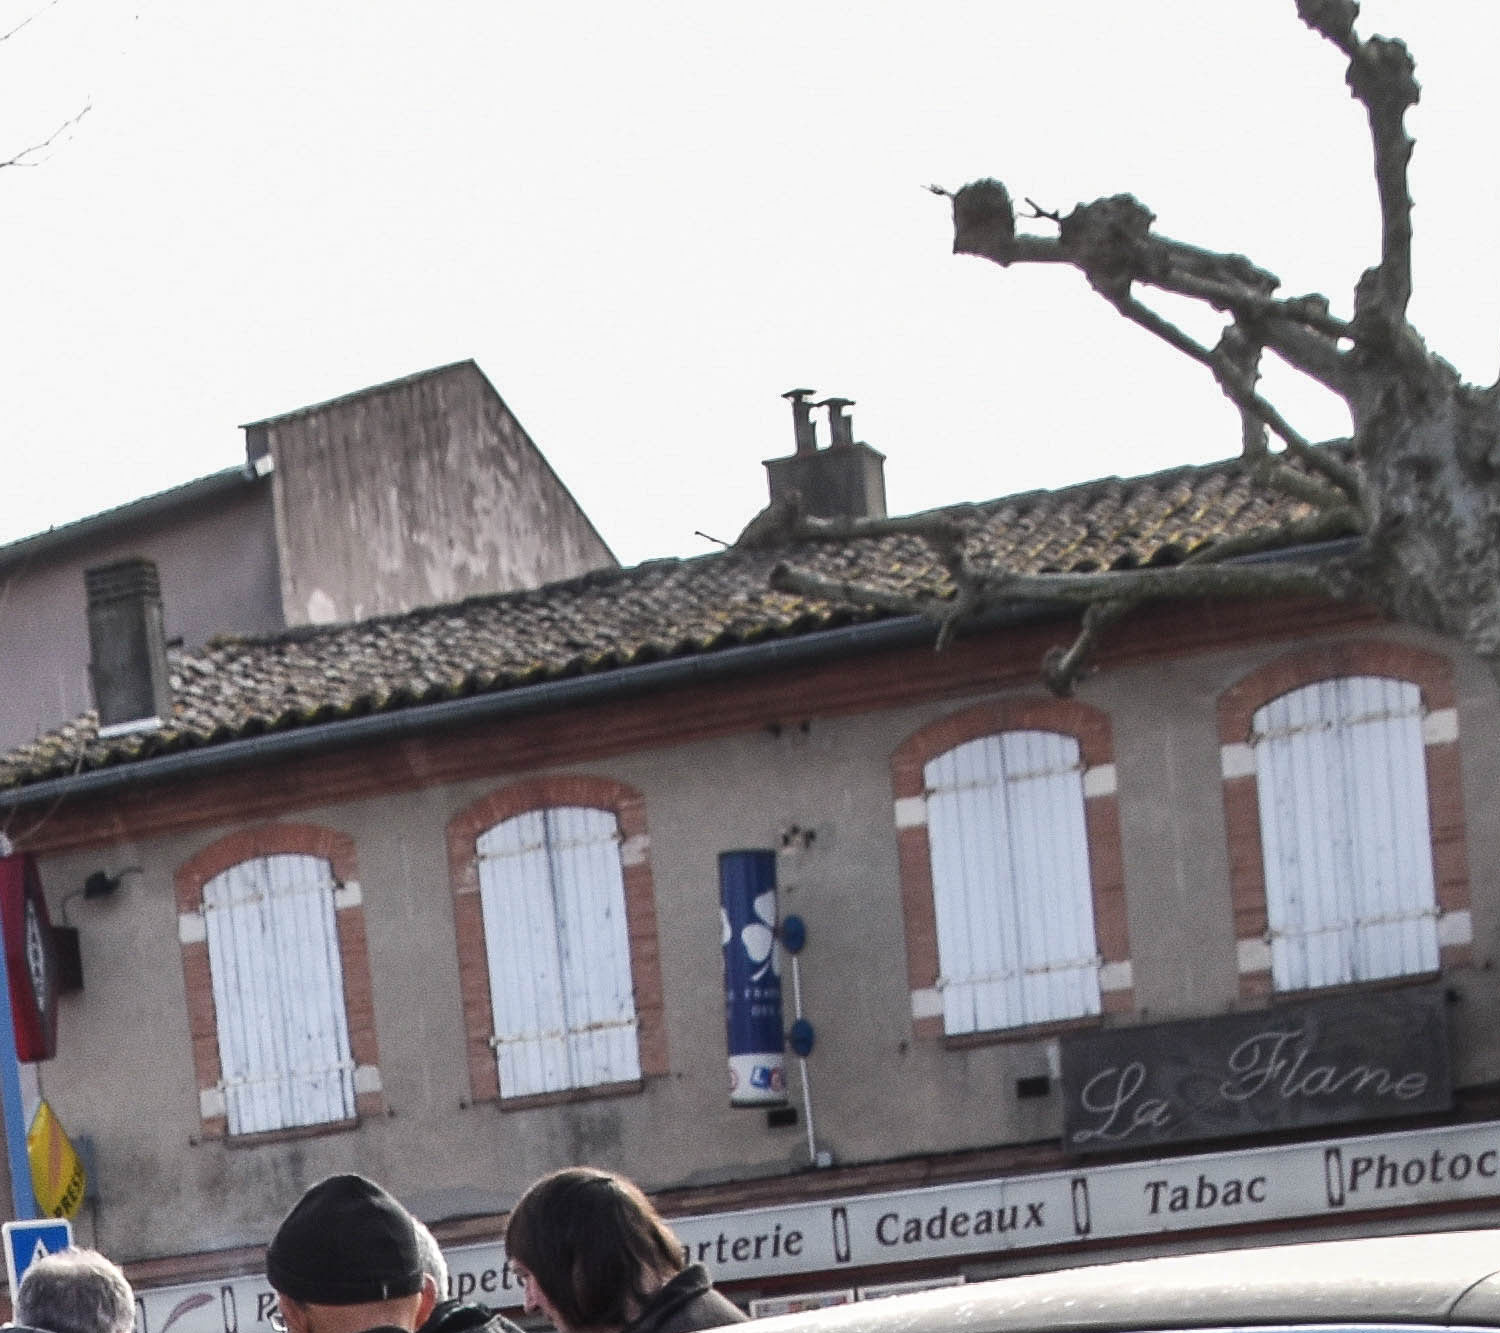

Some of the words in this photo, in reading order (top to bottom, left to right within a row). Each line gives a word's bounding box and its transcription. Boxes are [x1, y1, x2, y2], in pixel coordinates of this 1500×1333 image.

[1072, 1061, 1171, 1143] La
[681, 1223, 803, 1265] rterie
[874, 1200, 1046, 1247] Cadeaux
[1145, 1171, 1267, 1215] Tabac
